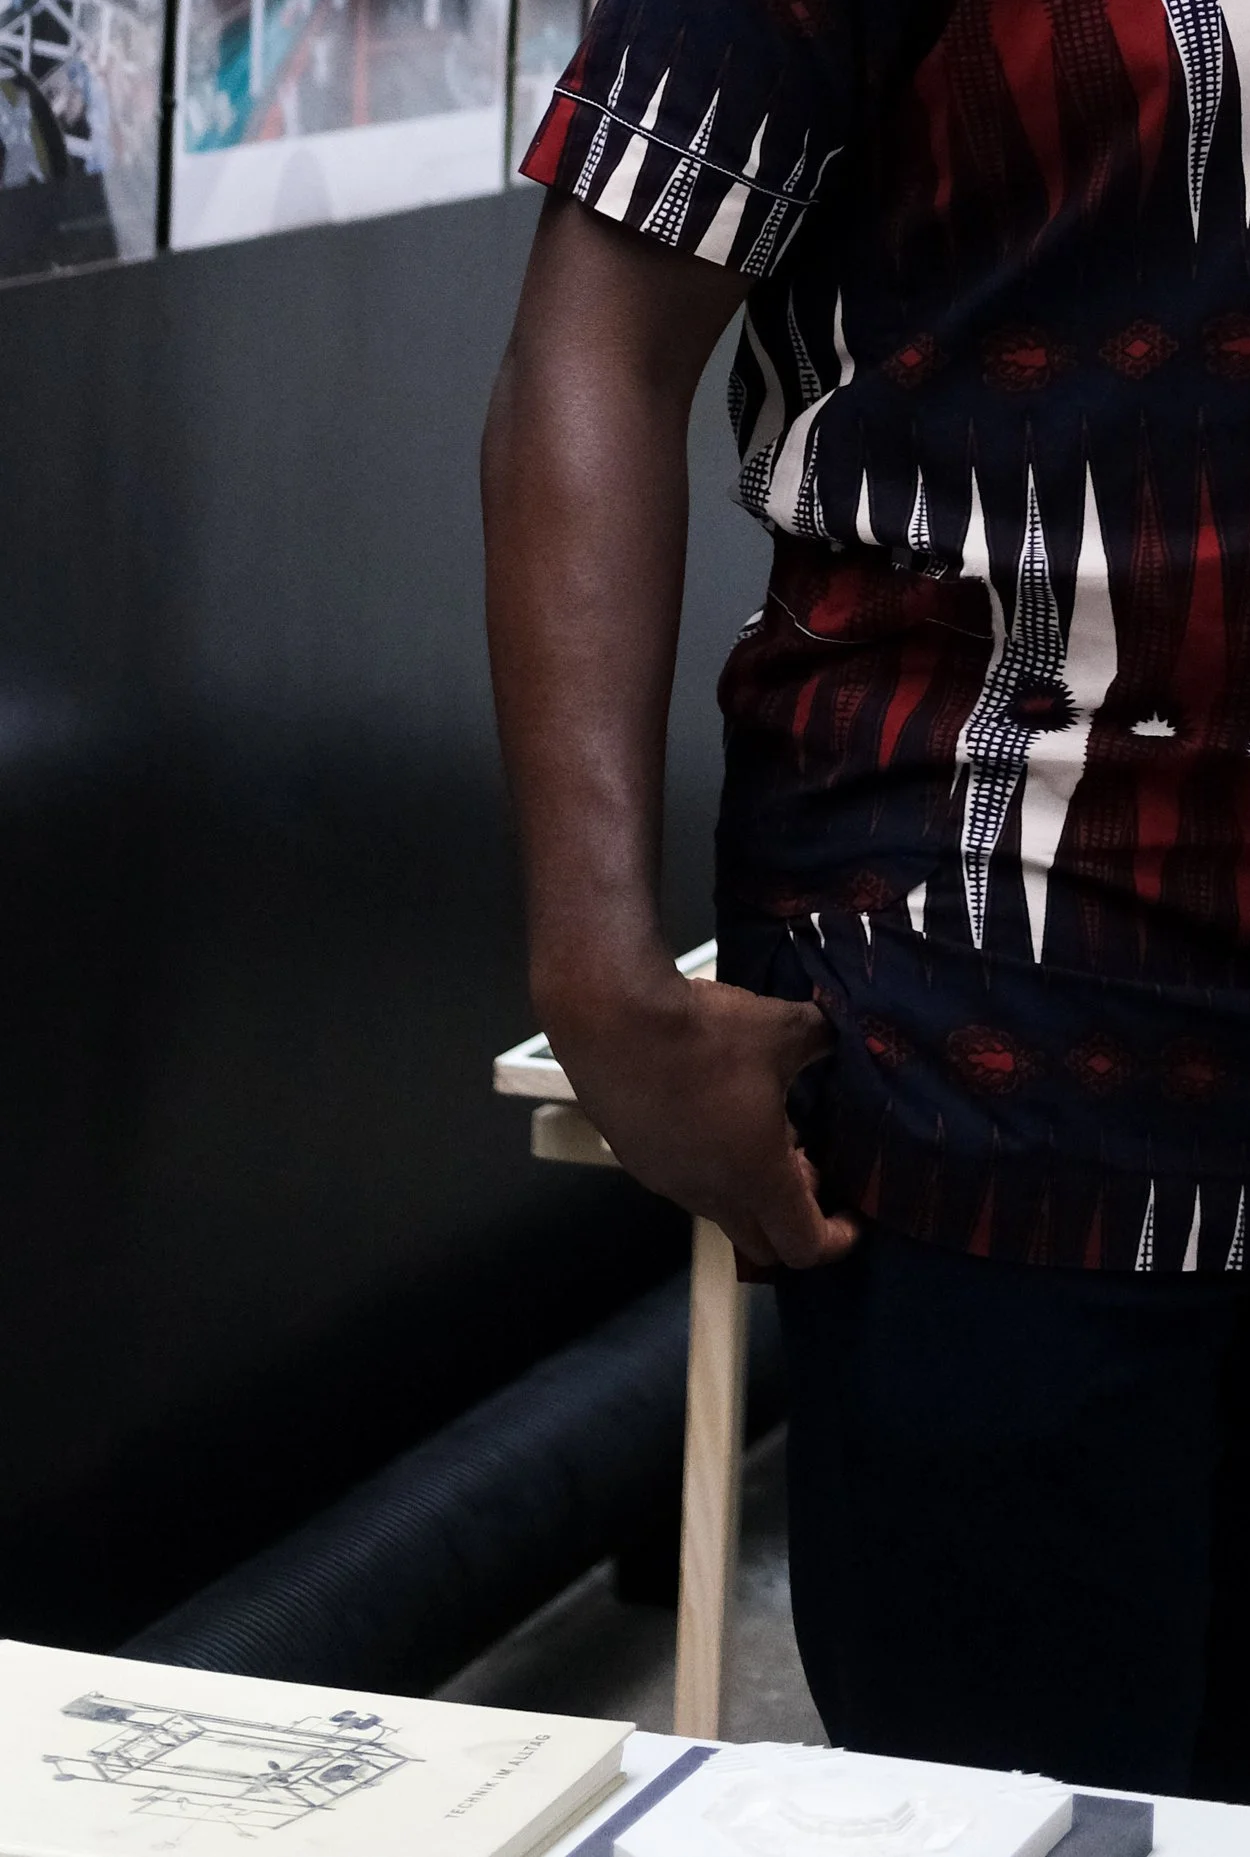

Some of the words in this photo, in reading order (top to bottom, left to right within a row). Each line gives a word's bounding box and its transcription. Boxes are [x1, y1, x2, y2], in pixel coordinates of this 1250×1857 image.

[444, 1781, 500, 1819] TECHNIK
[492, 1768, 514, 1779] IM
[508, 1734, 551, 1766] ALLTAG
